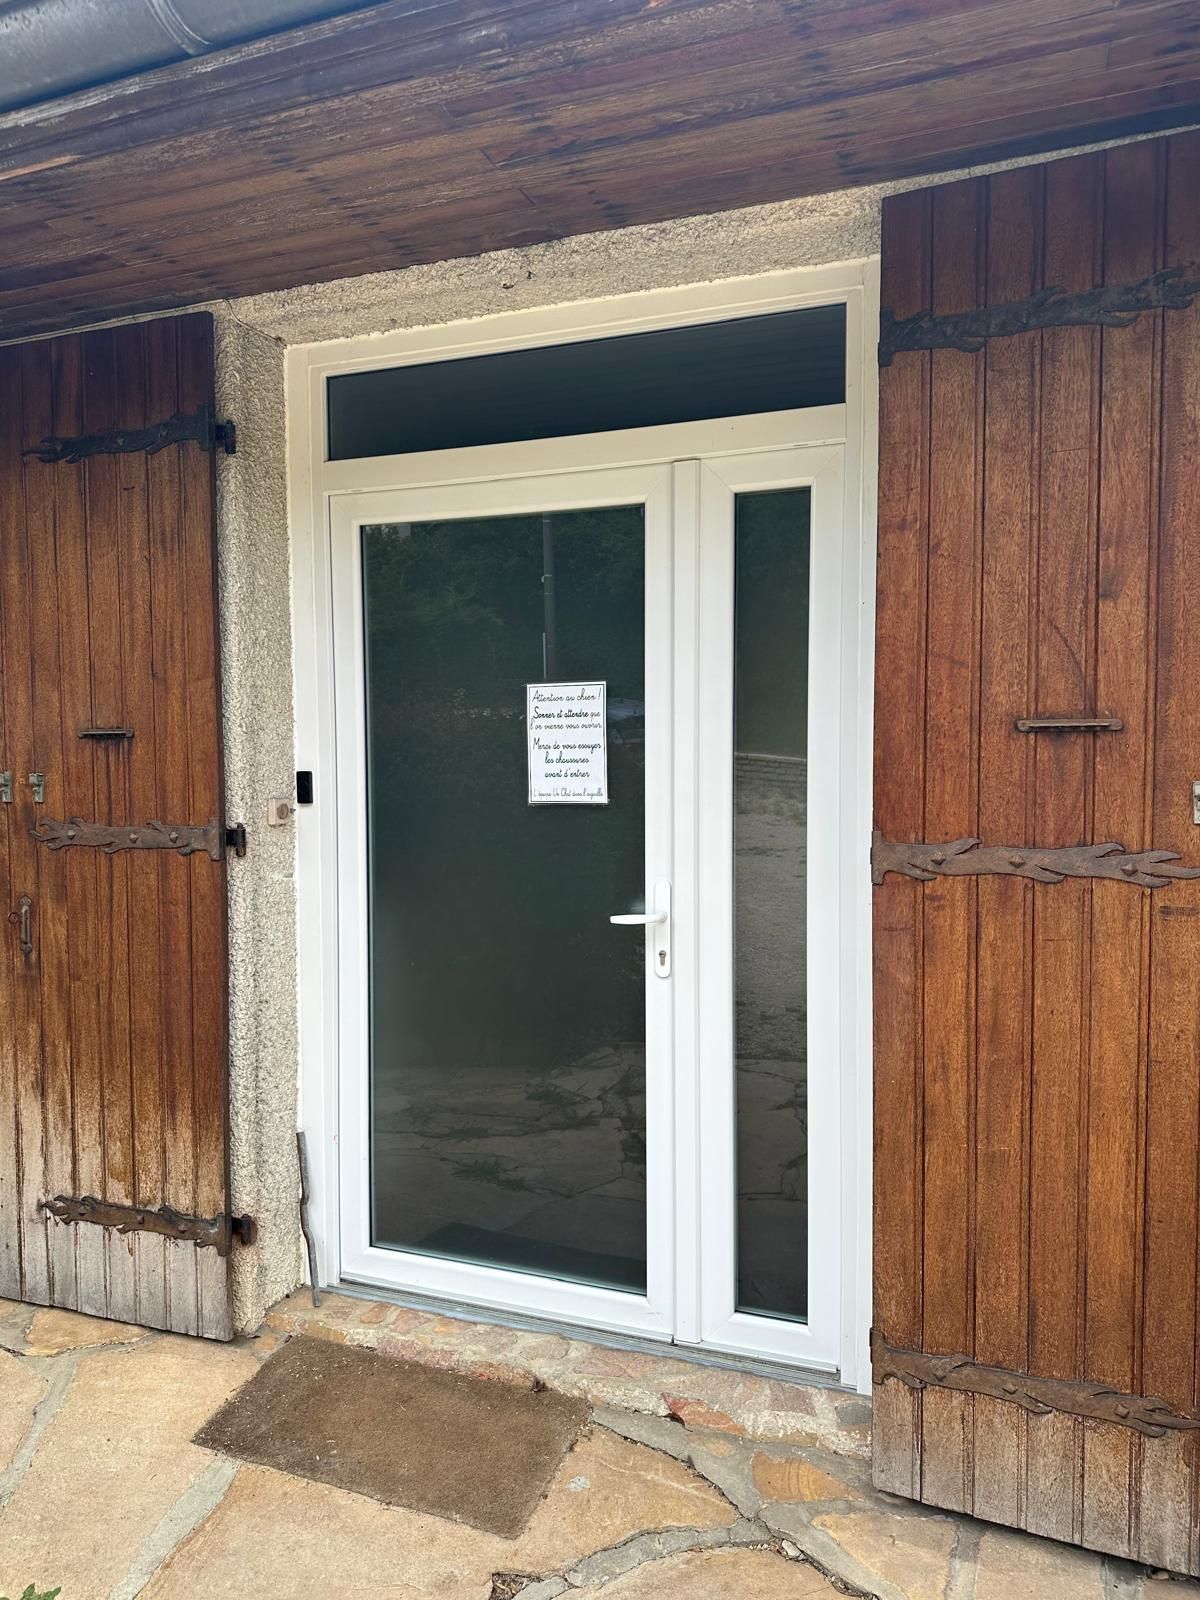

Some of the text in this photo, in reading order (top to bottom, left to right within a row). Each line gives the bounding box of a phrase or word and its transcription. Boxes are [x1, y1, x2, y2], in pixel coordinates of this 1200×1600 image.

[532, 690, 564, 702] Attention
[577, 688, 596, 702] chien
[533, 706, 600, 722] Sonner et attendre que
[533, 737, 551, 750] Merci
[552, 741, 561, 749] de
[578, 743, 601, 754] essuyer
[544, 751, 590, 764] les chaussures
[544, 768, 590, 778] avant d'entrer
